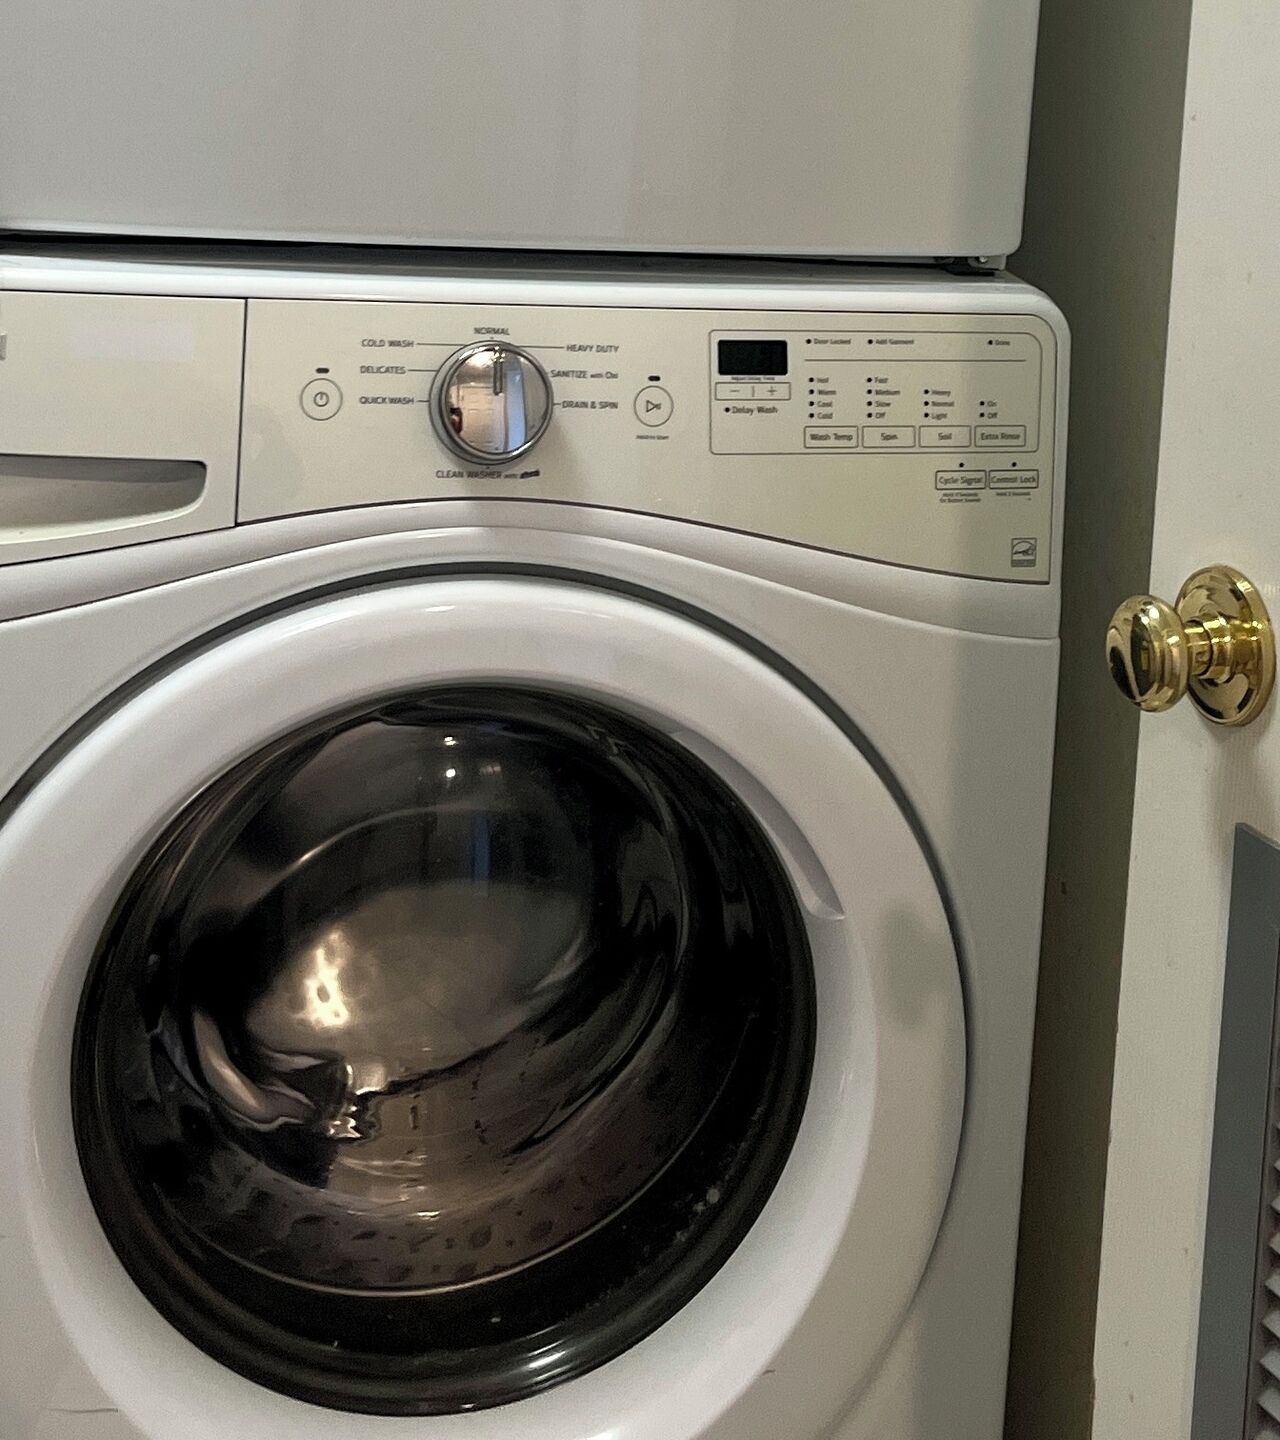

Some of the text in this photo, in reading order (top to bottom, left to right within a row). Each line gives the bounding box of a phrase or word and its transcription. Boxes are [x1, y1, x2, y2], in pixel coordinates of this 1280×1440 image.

[473, 327, 510, 336] NORMAL
[361, 339, 415, 348] COLD WASH
[566, 344, 620, 353] HEAVY DUTY
[360, 365, 407, 375] DELICATES
[550, 369, 588, 379] SANITIZE
[359, 395, 415, 405] QUICK WASH
[561, 401, 589, 410] DRAIN
[598, 401, 619, 410] SPIN
[731, 405, 779, 416] Delay Wash
[809, 432, 854, 442] Wash Temp
[880, 432, 899, 442] Spin
[937, 432, 953, 441] Soil
[980, 432, 1000, 441] Extra
[435, 470, 465, 479] CLEAN
[466, 470, 503, 479] WASHER
[1019, 475, 1037, 484] Lock
